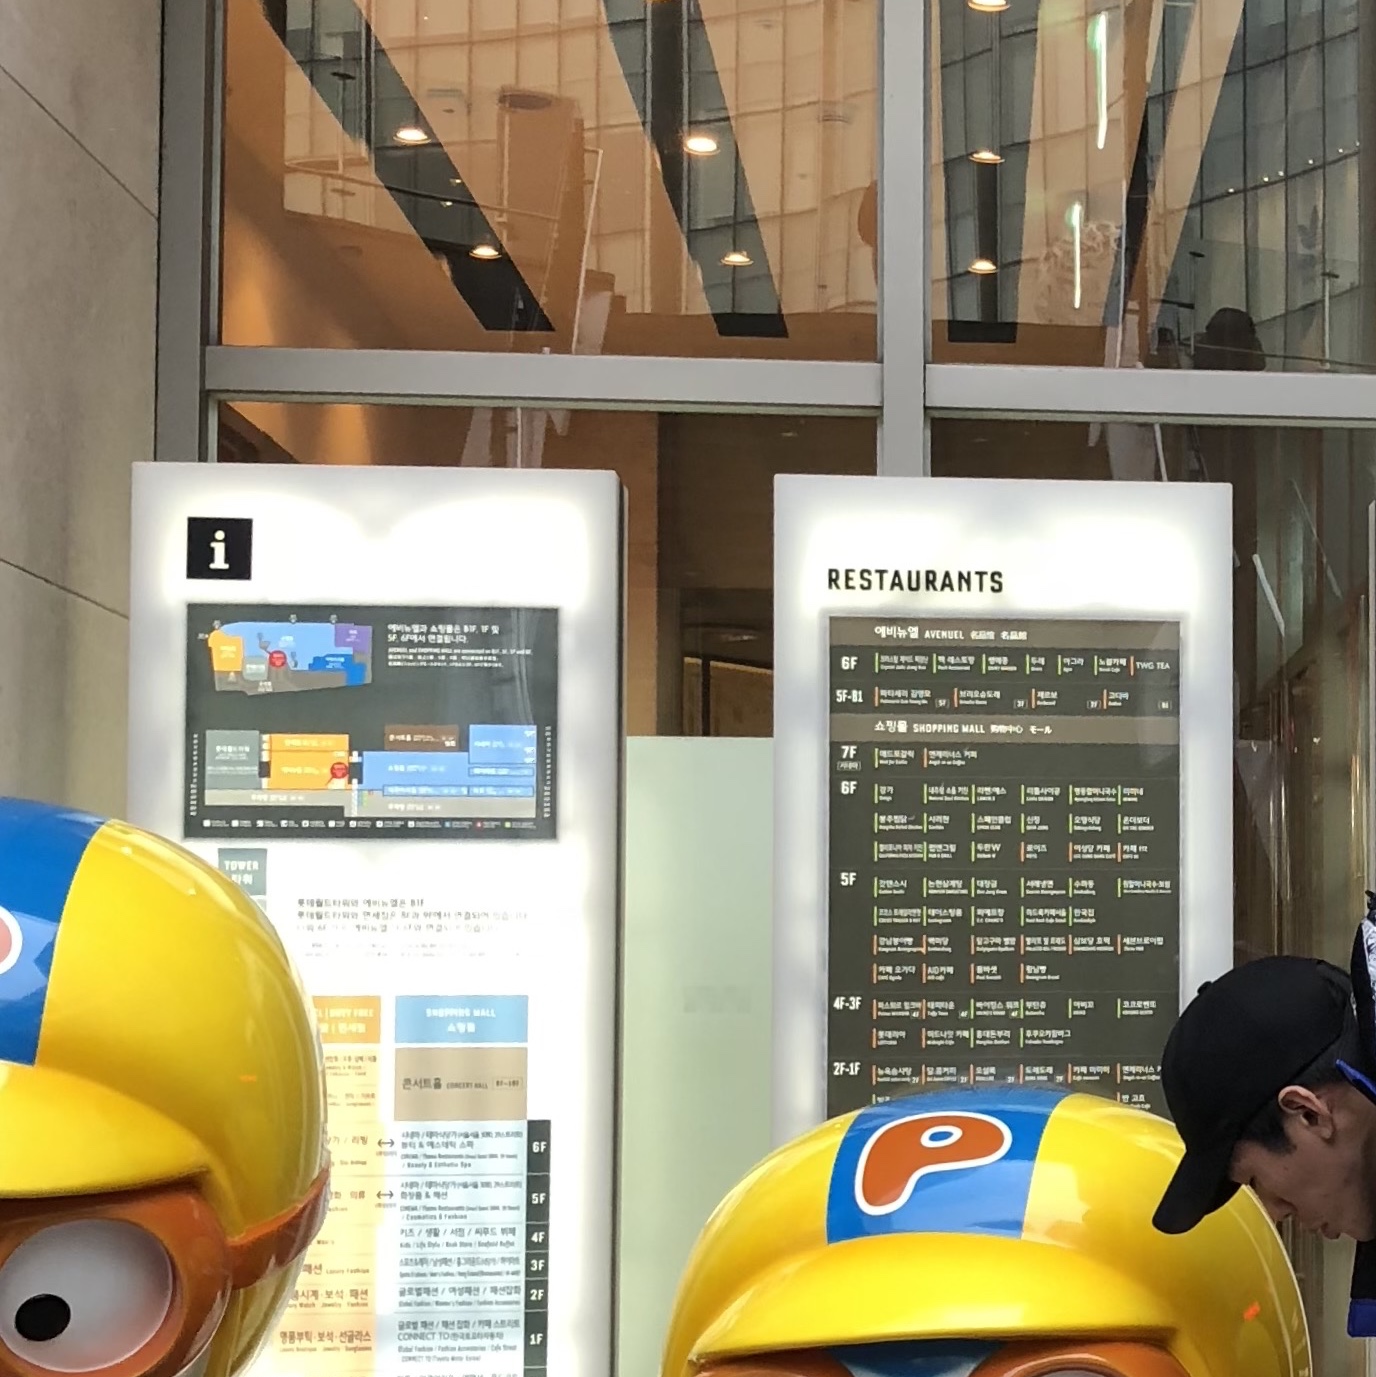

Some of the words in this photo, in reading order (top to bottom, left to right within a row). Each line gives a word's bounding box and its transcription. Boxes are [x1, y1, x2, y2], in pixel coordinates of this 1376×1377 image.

[827, 568, 1004, 593] RESTAURANTS
[874, 626, 919, 639] 에비뉴엘
[924, 630, 964, 639] AVENUEL
[841, 656, 858, 670] 6F
[1136, 662, 1154, 670] TWG
[836, 689, 863, 703] 5F-B1
[874, 720, 908, 733] 쇼핑몰
[913, 724, 959, 733] SHOPPING
[962, 724, 985, 733] MALL
[1030, 726, 1052, 734] モール
[841, 746, 857, 759] 7F
[840, 781, 857, 794] 6F
[224, 861, 258, 870] TOWER
[840, 872, 857, 886] 5F
[833, 997, 862, 1010] 4F-3F
[833, 1062, 861, 1075] 2F-1F
[403, 1078, 441, 1090] 콘서트홀
[532, 1142, 547, 1152] 6F
[532, 1193, 546, 1204] 5F
[531, 1232, 545, 1242] 4F
[531, 1260, 545, 1271] 3F
[530, 1290, 544, 1300] 2F
[530, 1334, 543, 1345] 1F
